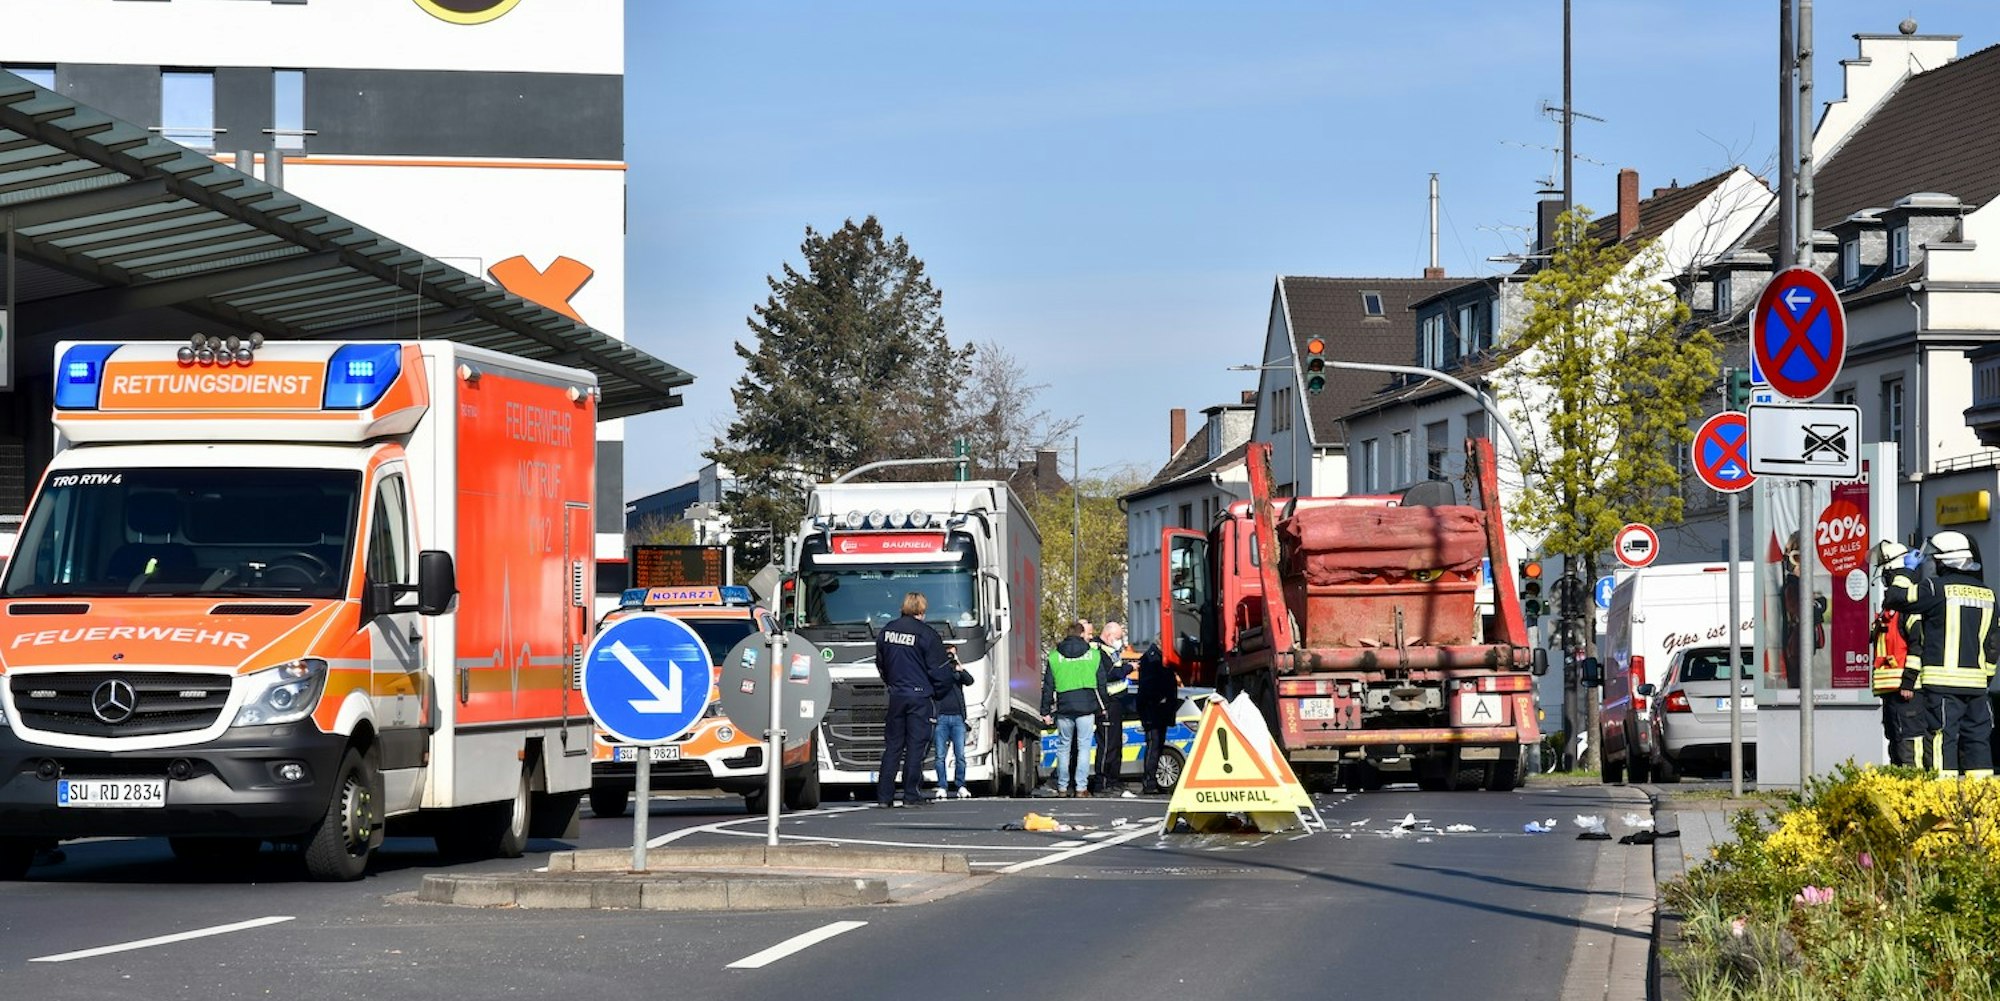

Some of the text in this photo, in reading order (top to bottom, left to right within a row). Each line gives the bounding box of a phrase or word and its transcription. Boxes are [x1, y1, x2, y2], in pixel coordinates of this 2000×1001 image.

[112, 373, 312, 395] RETTUNGSDIENST
[506, 402, 572, 447] FEUERWEHR
[53, 474, 122, 487] TRO RTW 4
[518, 460, 561, 498] NOTRUF
[1817, 514, 1866, 545] 20%
[1823, 541, 1862, 558] AUF ALLES
[652, 590, 715, 600] NOTARZT
[1947, 587, 1993, 599] FEUERWEHR
[10, 626, 250, 649] FEUERWEHR
[884, 630, 916, 647] POLIZEI
[1662, 632, 1701, 655] Gips
[1706, 624, 1727, 640] ist
[1472, 698, 1492, 719] A
[620, 748, 678, 759] SU 9821
[70, 784, 161, 800] SU RD 2834
[1196, 790, 1271, 803] OELUNFALL
